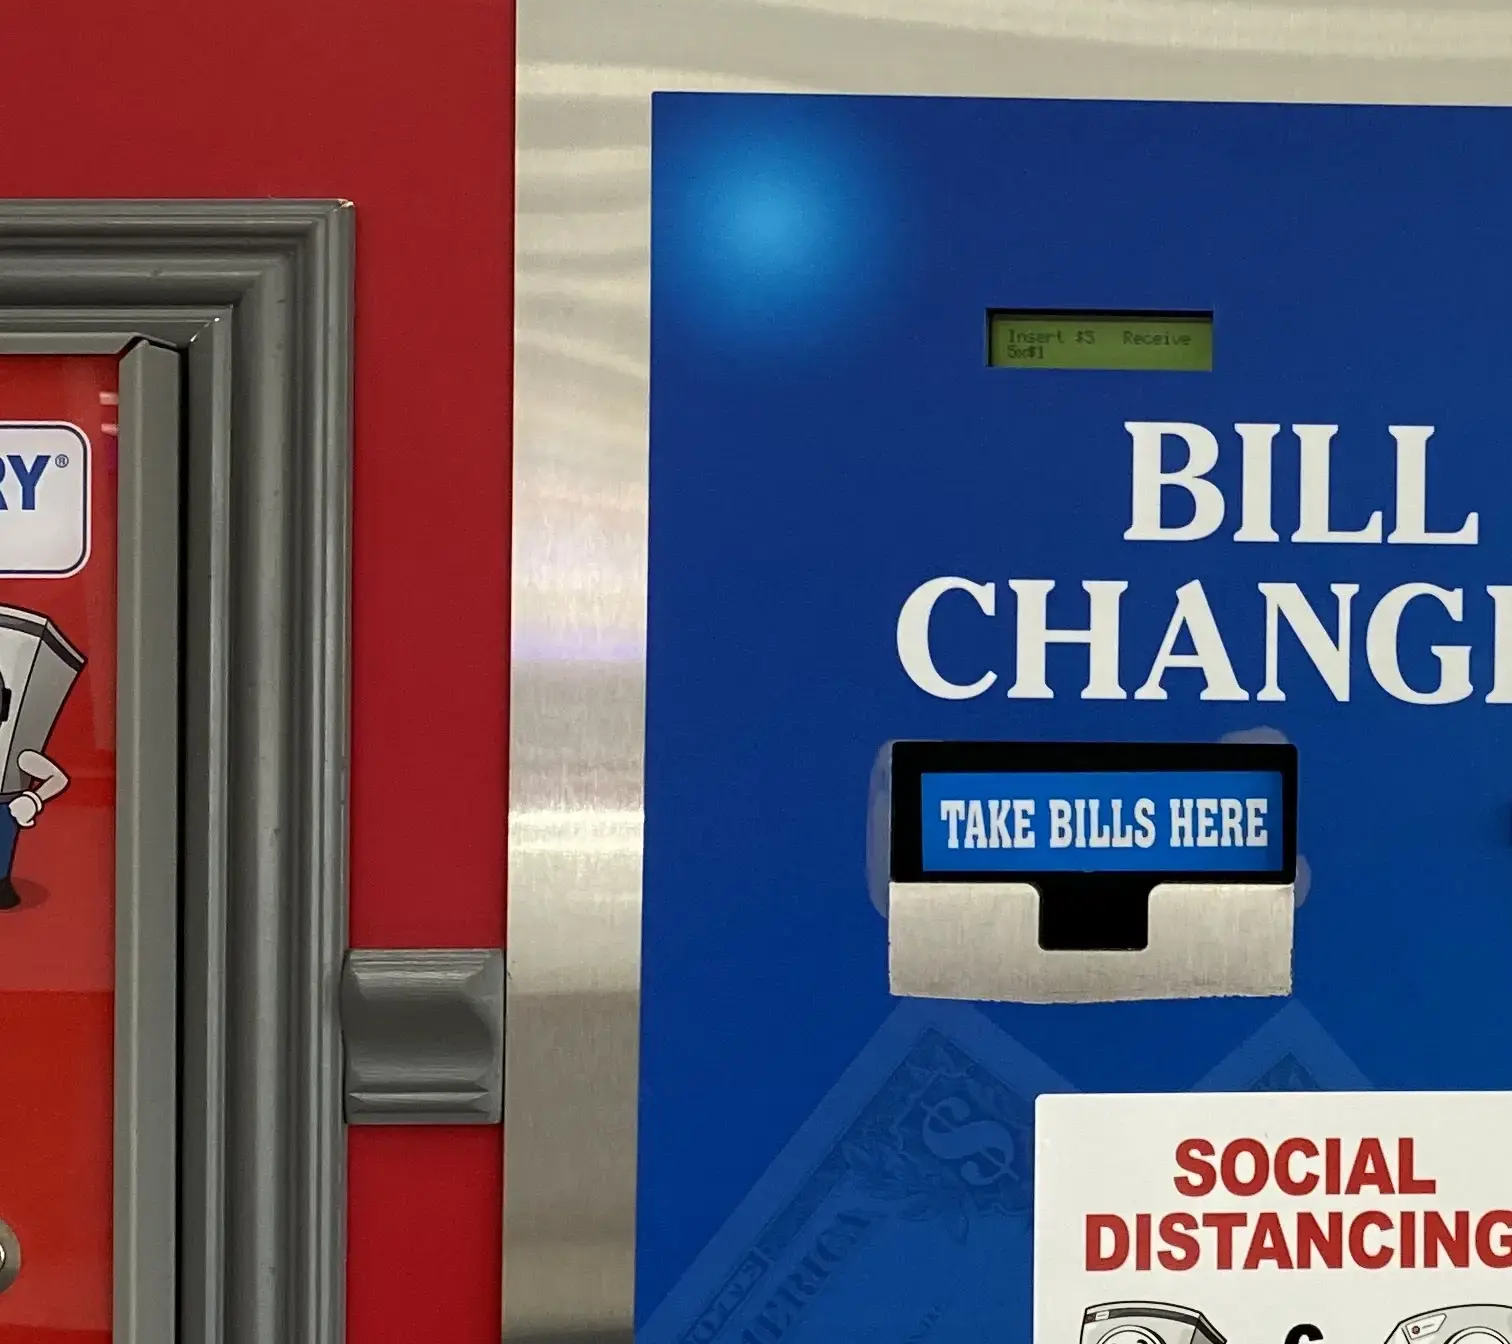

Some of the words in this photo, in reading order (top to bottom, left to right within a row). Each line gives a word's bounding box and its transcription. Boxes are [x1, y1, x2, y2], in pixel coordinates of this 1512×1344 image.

[1008, 330, 1065, 344] Insert
[1124, 331, 1191, 345] Receive
[1124, 422, 1478, 544] BILL
[941, 800, 1035, 848] TAKE
[1049, 798, 1155, 848] BILLS
[1170, 799, 1267, 847] HERE
[1174, 1137, 1436, 1197] SOCIAL
